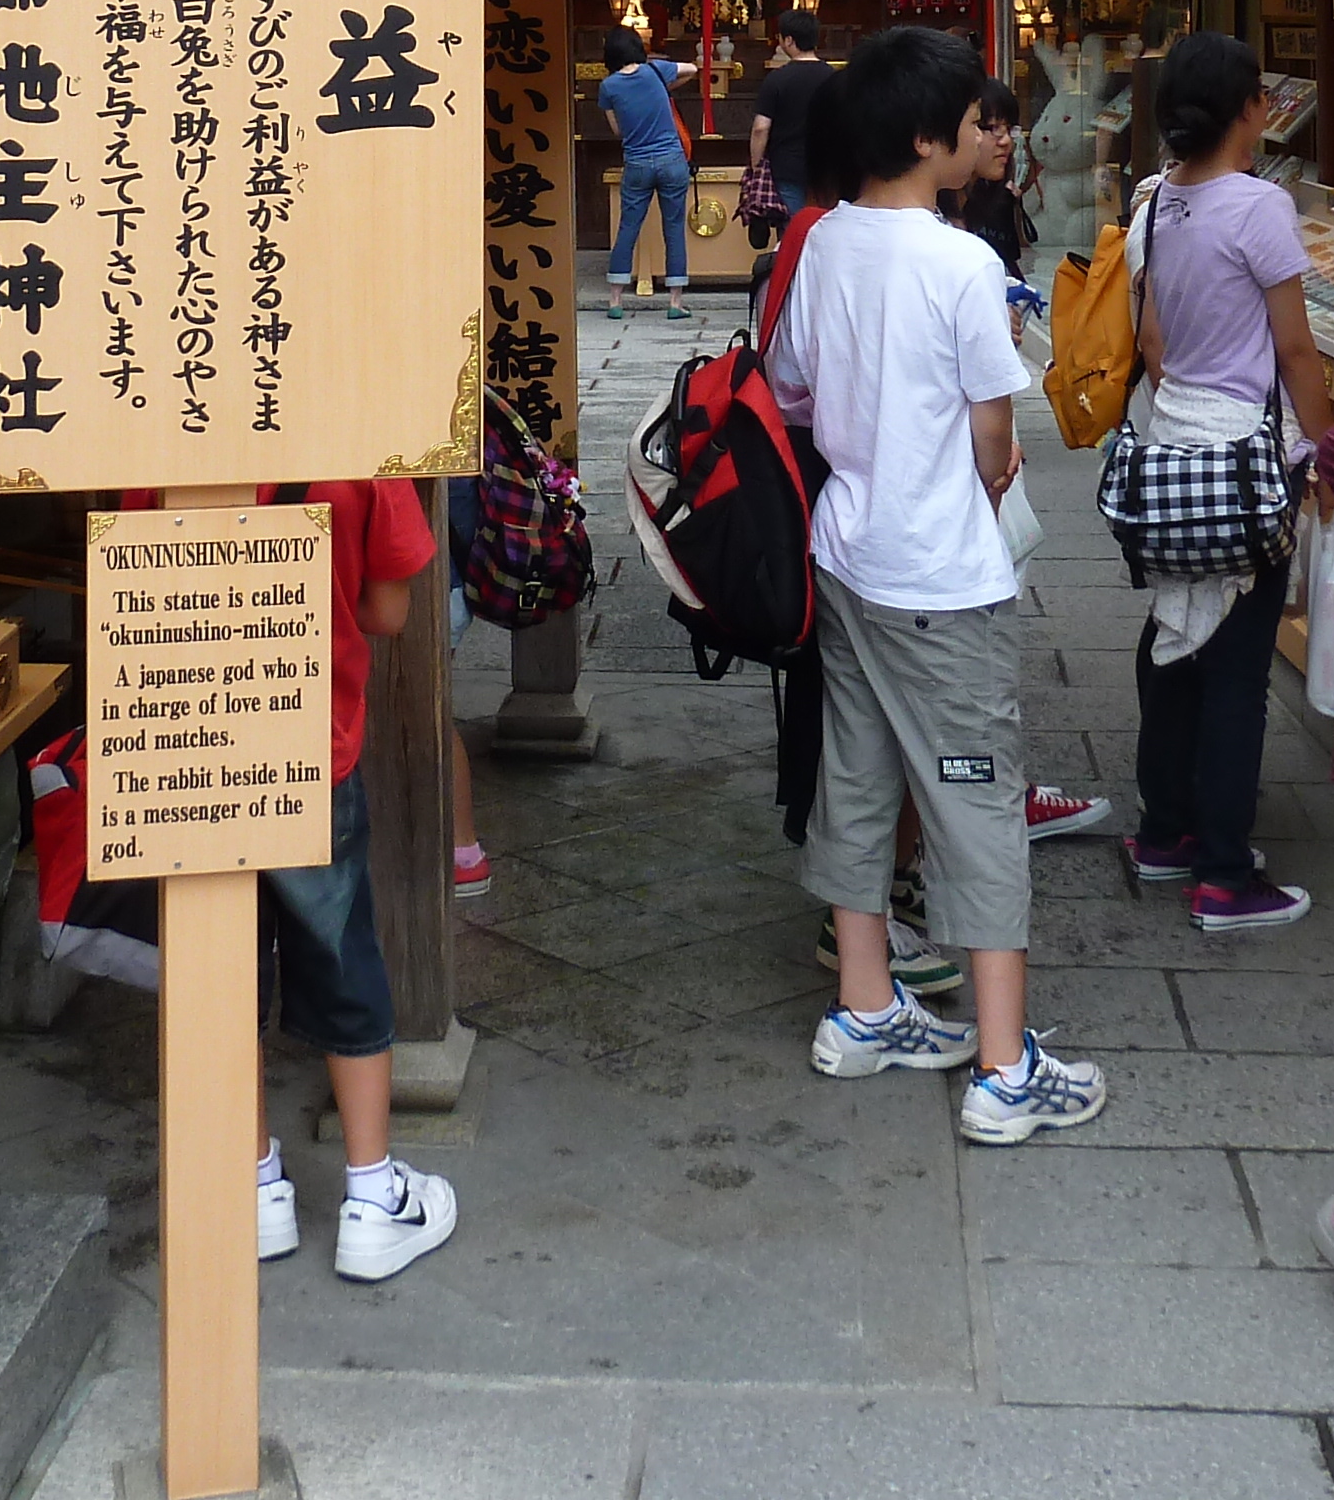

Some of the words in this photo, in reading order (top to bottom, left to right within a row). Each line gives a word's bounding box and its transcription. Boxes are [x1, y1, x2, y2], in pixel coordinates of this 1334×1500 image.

[113, 590, 155, 613] This
[164, 591, 220, 611] statue
[228, 586, 243, 608] is
[252, 583, 305, 606] called
[115, 665, 130, 687] A
[139, 664, 215, 689] japanese
[223, 659, 254, 685] god
[262, 657, 297, 679] who
[305, 656, 319, 678] is
[102, 699, 120, 720] in
[129, 697, 190, 720] charge
[199, 693, 217, 715] of
[225, 692, 260, 713] love
[269, 688, 301, 711] and
[102, 729, 146, 756] good
[155, 726, 234, 750] matches.
[113, 771, 149, 793] The
[158, 767, 213, 791] rabbit
[221, 763, 277, 787] beside
[286, 761, 320, 783] him
[102, 805, 117, 827] is
[125, 810, 135, 825] a
[144, 803, 241, 828] messenger
[249, 795, 267, 817] of
[275, 794, 303, 815] the
[102, 836, 143, 863] god.
